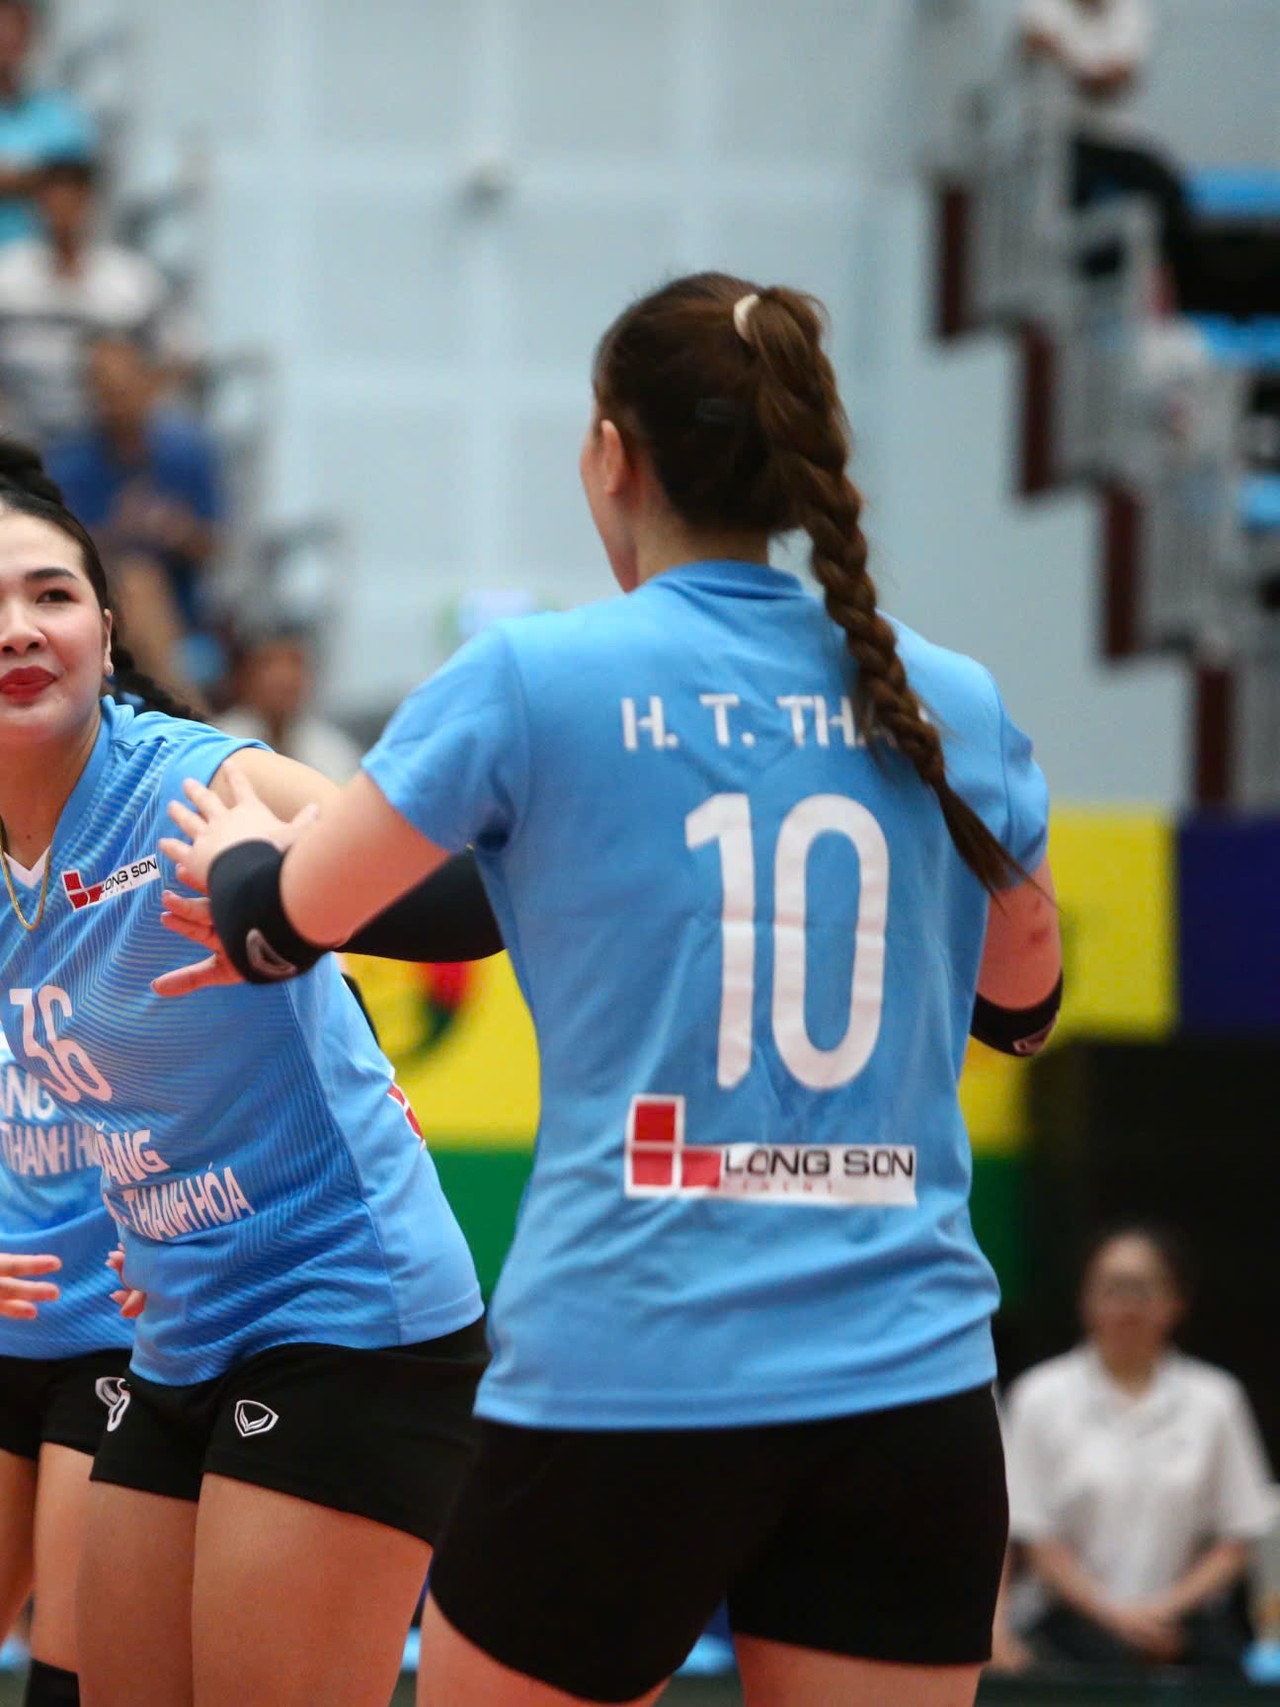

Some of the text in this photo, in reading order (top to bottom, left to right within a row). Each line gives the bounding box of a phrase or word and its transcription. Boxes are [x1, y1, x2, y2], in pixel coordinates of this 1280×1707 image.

[622, 695, 678, 749] H.
[700, 693, 756, 747] T.
[131, 858, 158, 878] SON
[685, 793, 890, 1089] 10
[9, 985, 112, 1102] 36
[95, 1121, 171, 1185] ĂNG
[724, 1148, 914, 1177] LONG SON
[122, 1180, 202, 1241] THANH
[186, 1161, 257, 1229] HÓA
